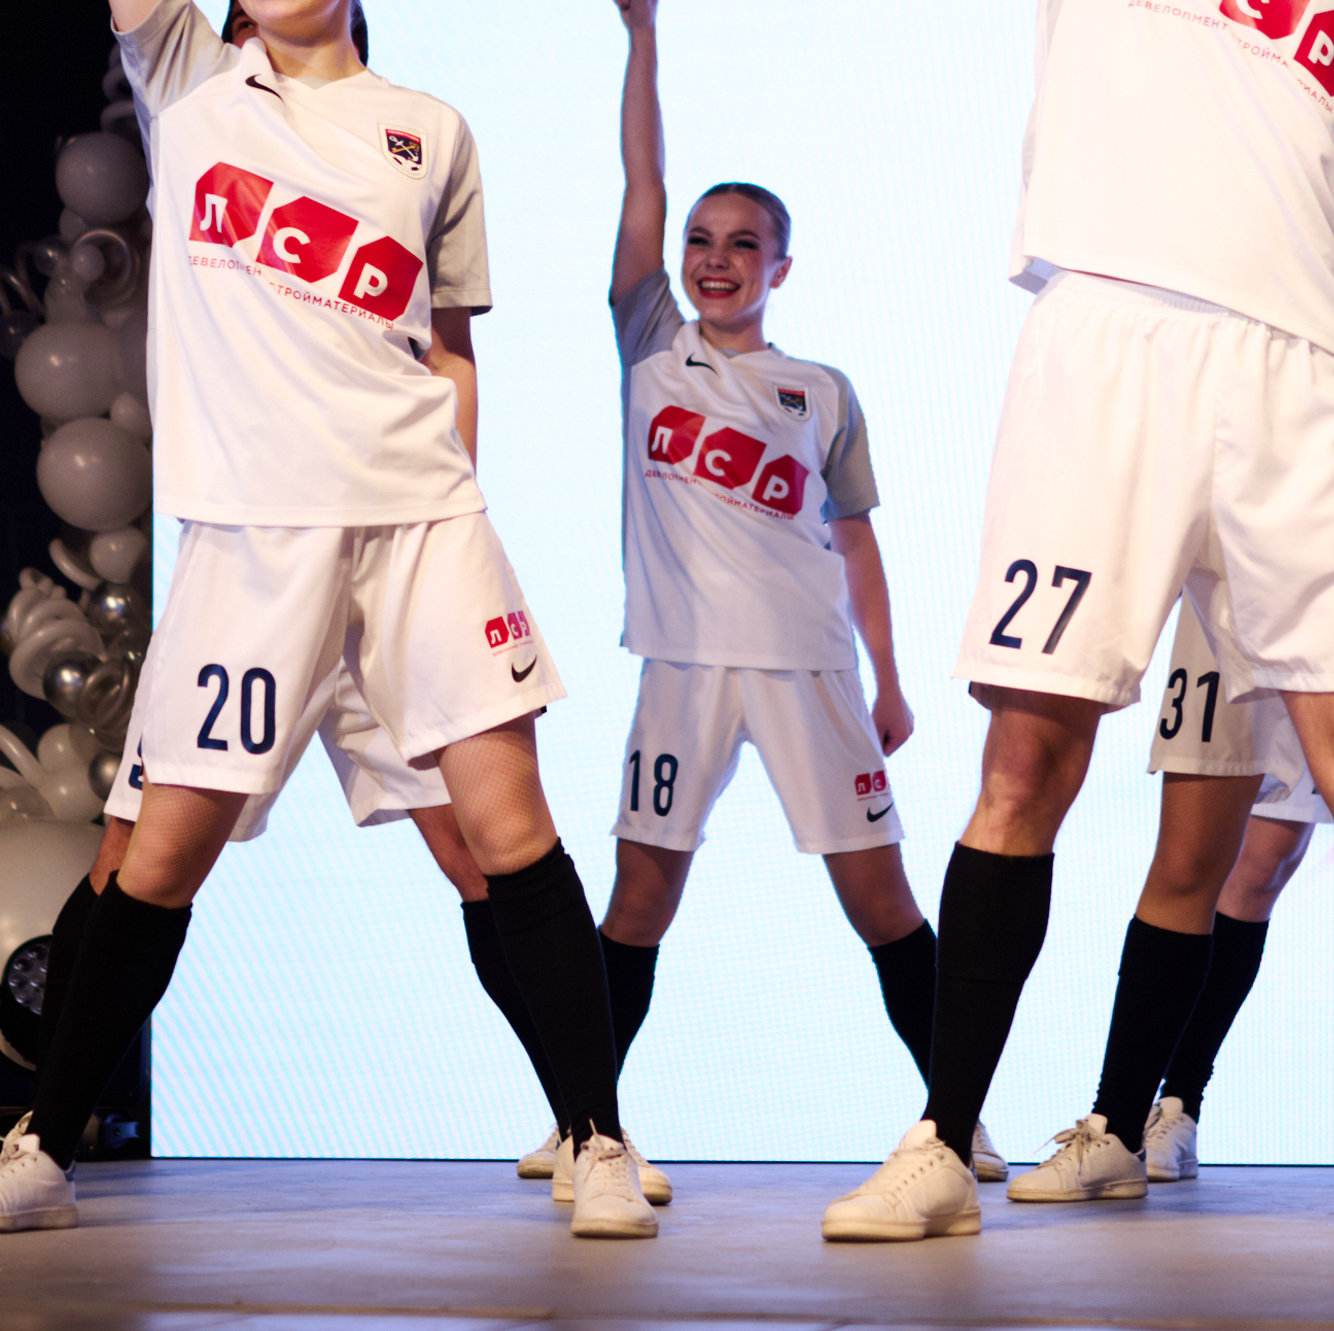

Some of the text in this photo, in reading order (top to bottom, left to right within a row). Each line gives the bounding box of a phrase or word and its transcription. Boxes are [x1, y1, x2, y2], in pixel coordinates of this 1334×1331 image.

[198, 192, 390, 300] ЛСР
[269, 282, 395, 331] ТРОЙМАТЕРИАЛЫ
[650, 425, 790, 503] ЛСР
[989, 558, 1093, 655] 27
[197, 663, 277, 755] 20
[1159, 667, 1221, 744] 31
[628, 749, 679, 818] 18
